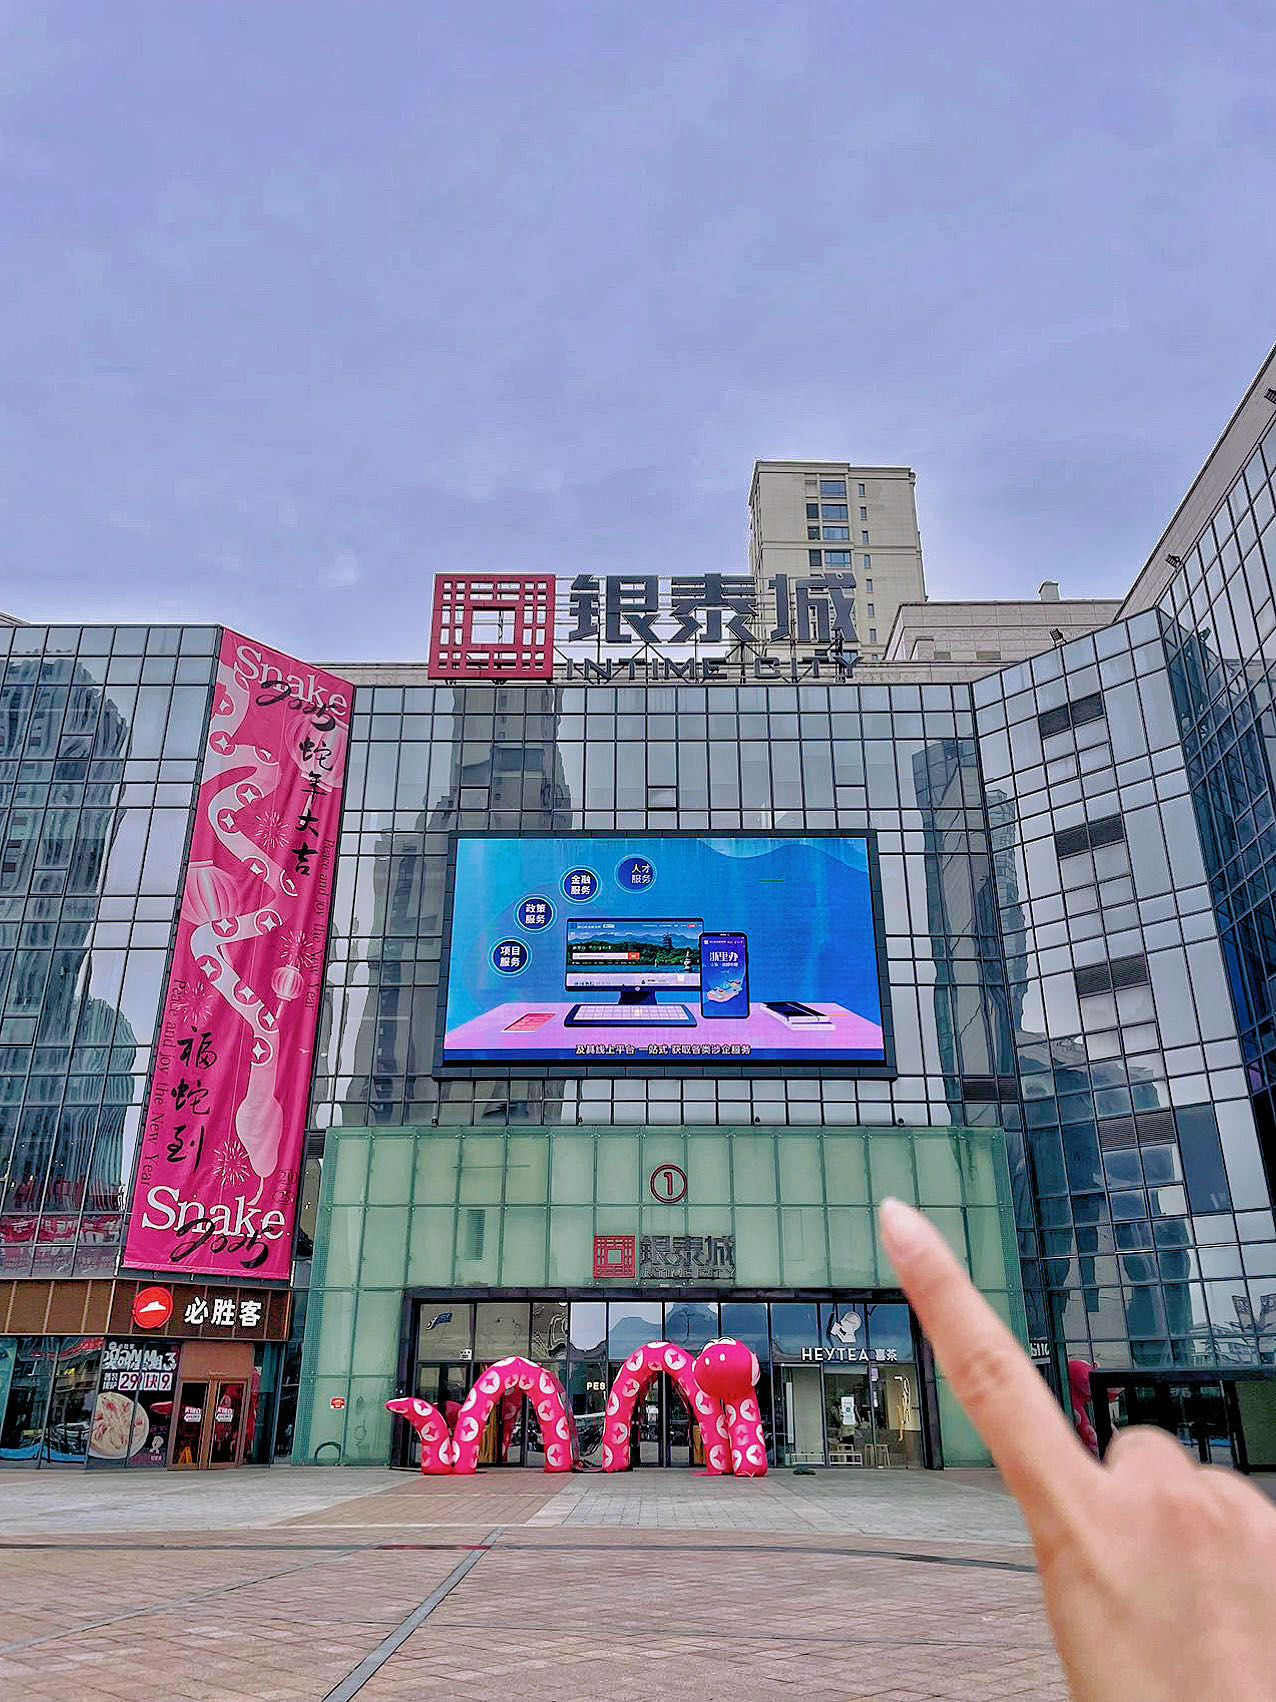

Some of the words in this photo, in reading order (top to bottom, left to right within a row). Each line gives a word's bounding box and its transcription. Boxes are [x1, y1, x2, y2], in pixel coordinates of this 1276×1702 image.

[234, 645, 347, 716] Snake
[567, 657, 728, 681] INTIME
[755, 655, 863, 679] CITY
[291, 736, 333, 876] 蛇年大吉
[571, 874, 591, 885] 金融
[631, 874, 652, 884] 服务
[632, 863, 652, 874] 人才
[318, 873, 330, 897] and
[570, 885, 591, 895] 服务
[525, 903, 546, 914] 政策
[525, 914, 546, 924] 服务
[313, 922, 326, 944] the
[499, 957, 521, 967] 服务
[500, 946, 521, 957] 项目
[167, 978, 187, 1018] Peace
[164, 1021, 177, 1047] and
[158, 1050, 175, 1076] joy
[153, 1081, 169, 1106] the
[166, 1025, 218, 1173] 福蛇到
[148, 1111, 165, 1144] New
[140, 1154, 160, 1187] Year
[142, 1185, 286, 1240] Snake
[184, 1296, 262, 1327] 必胜客
[801, 1347, 869, 1361] HEYTEA
[875, 1348, 897, 1361] 喜茶
